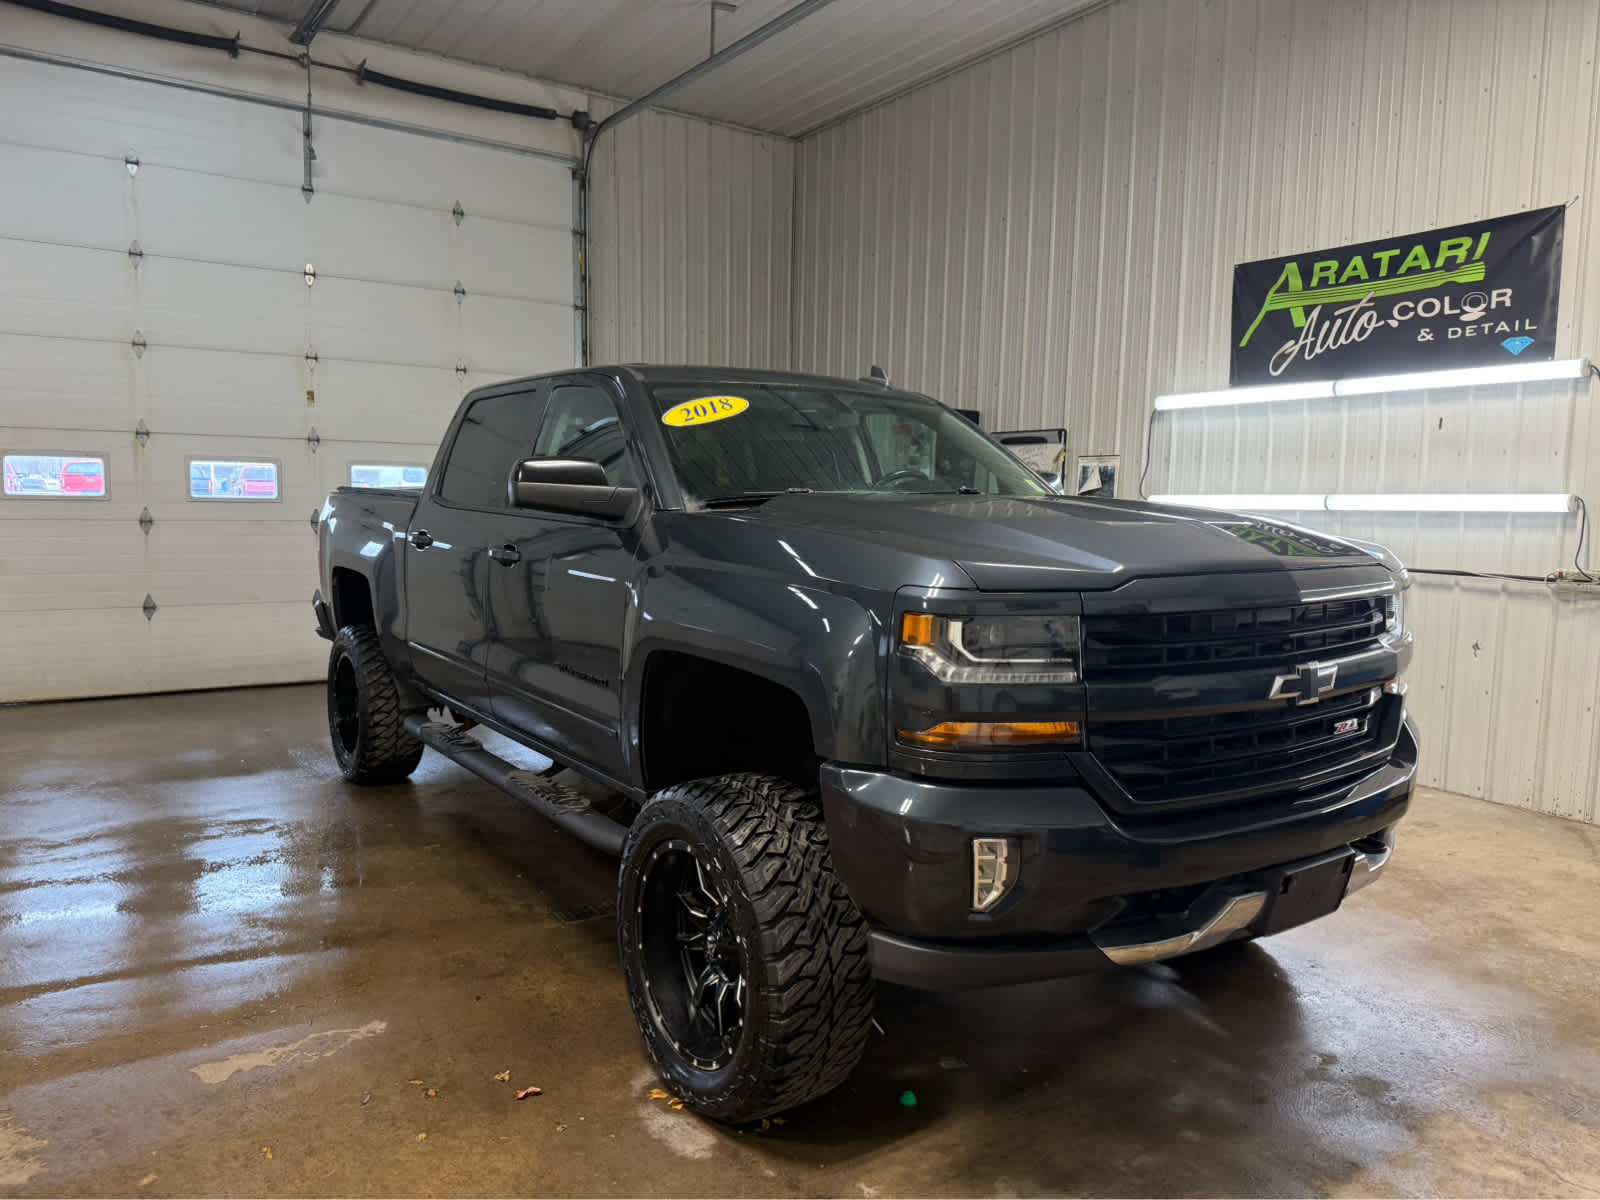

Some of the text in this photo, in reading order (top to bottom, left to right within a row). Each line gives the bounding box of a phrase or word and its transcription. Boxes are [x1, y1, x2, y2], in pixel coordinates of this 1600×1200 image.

[1240, 232, 1491, 347] ARATARI
[1269, 288, 1513, 376] Auto COLOR
[1416, 318, 1538, 342] & DETAIL
[680, 398, 733, 422] 2018
